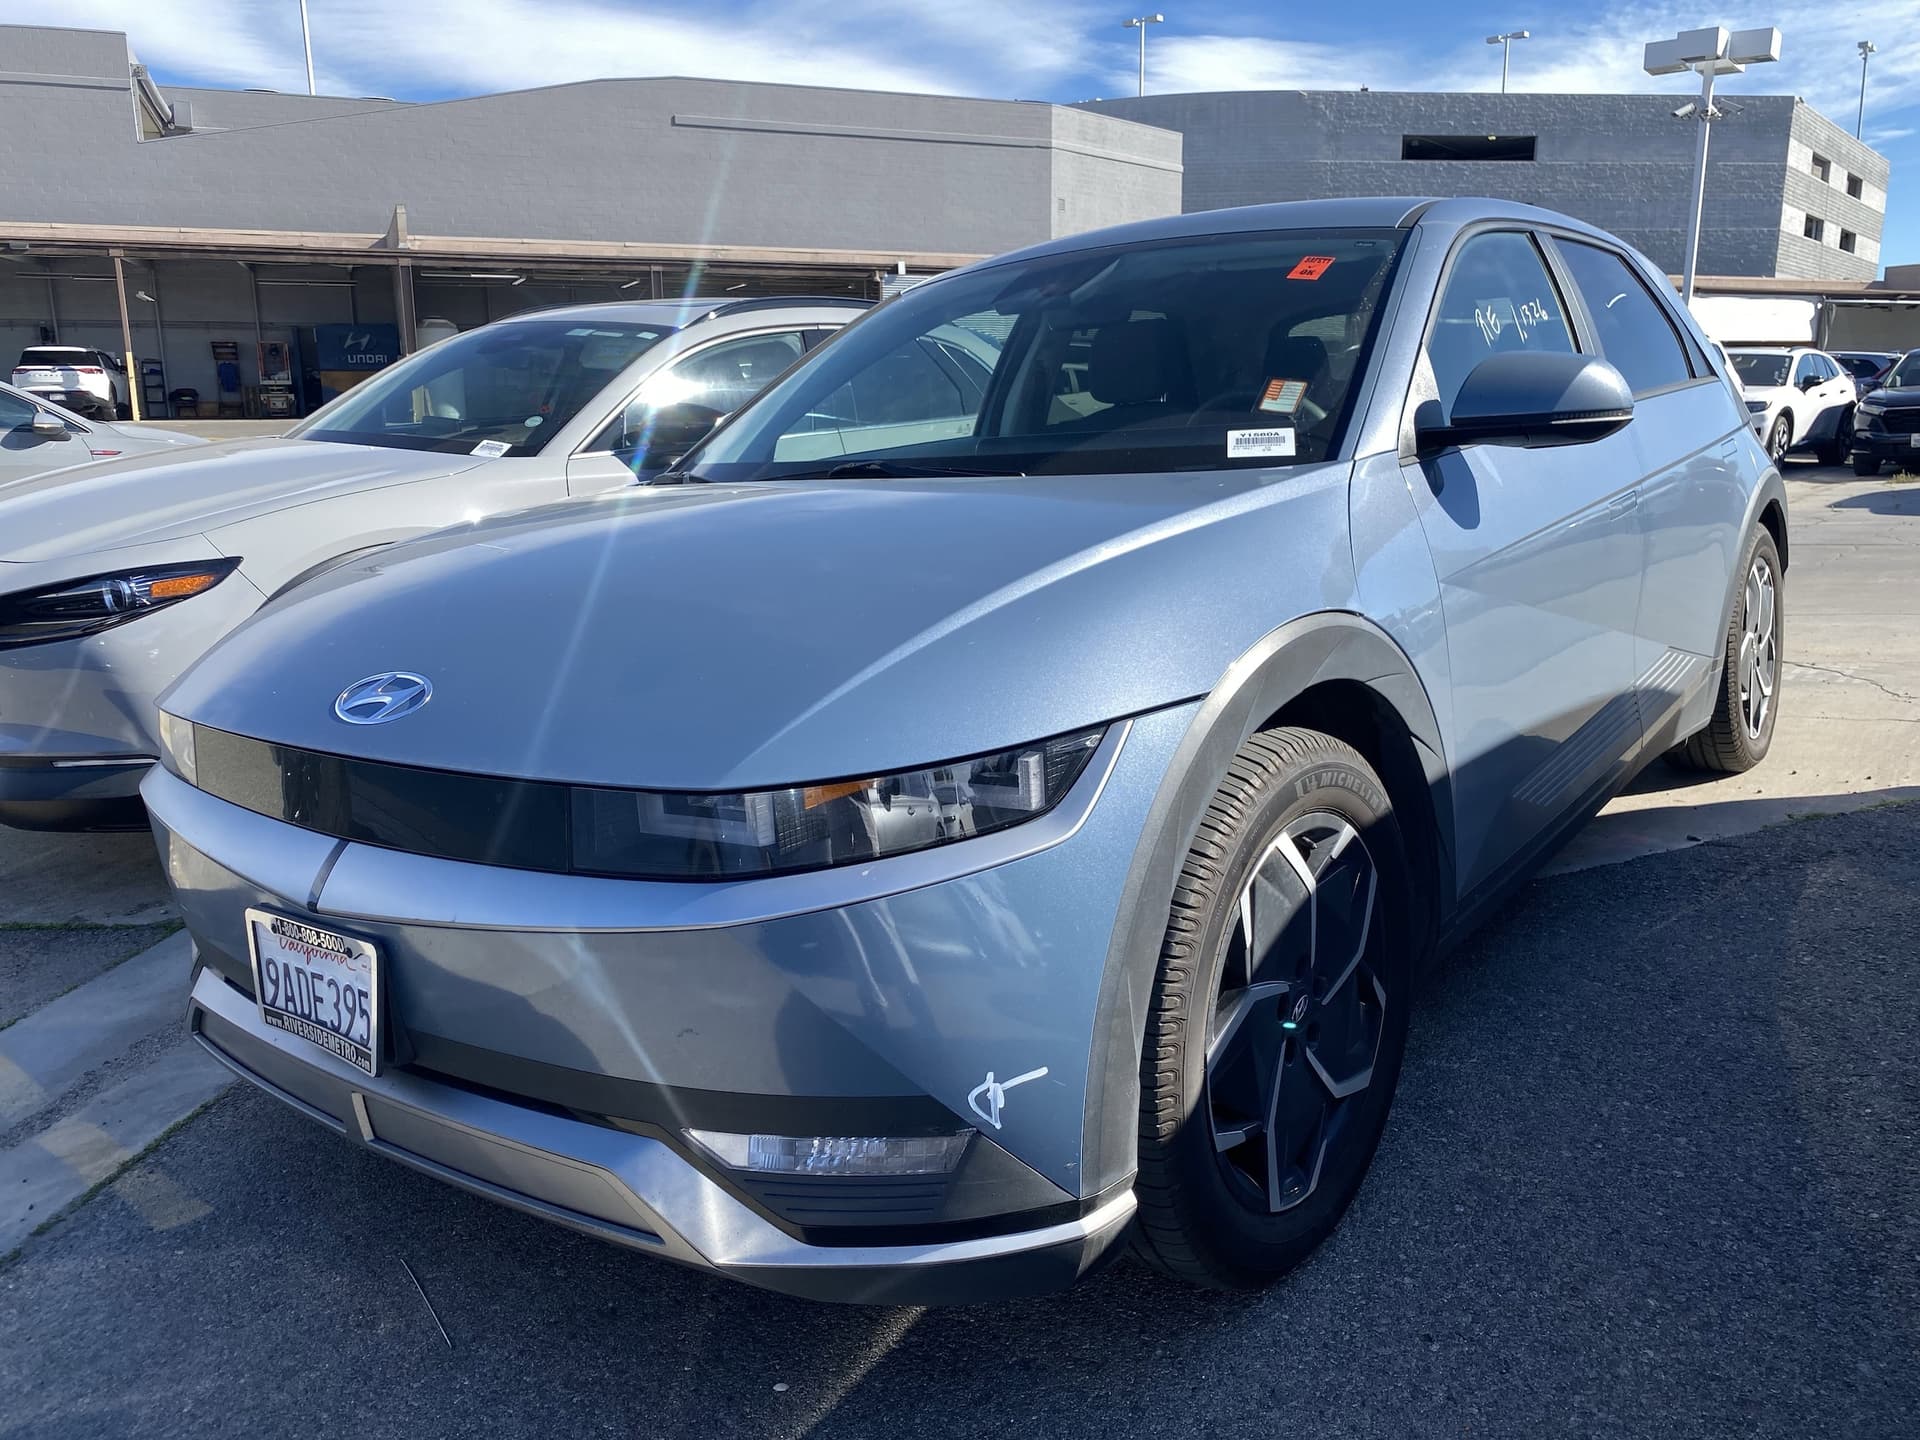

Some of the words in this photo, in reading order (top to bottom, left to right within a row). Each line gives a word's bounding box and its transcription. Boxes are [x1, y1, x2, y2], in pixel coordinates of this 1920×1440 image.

[1319, 770, 1386, 814] MICHELIN
[265, 957, 371, 1048] 9ADE395
[266, 1015, 371, 1072] www.RIVERSIDEMETRO.com
